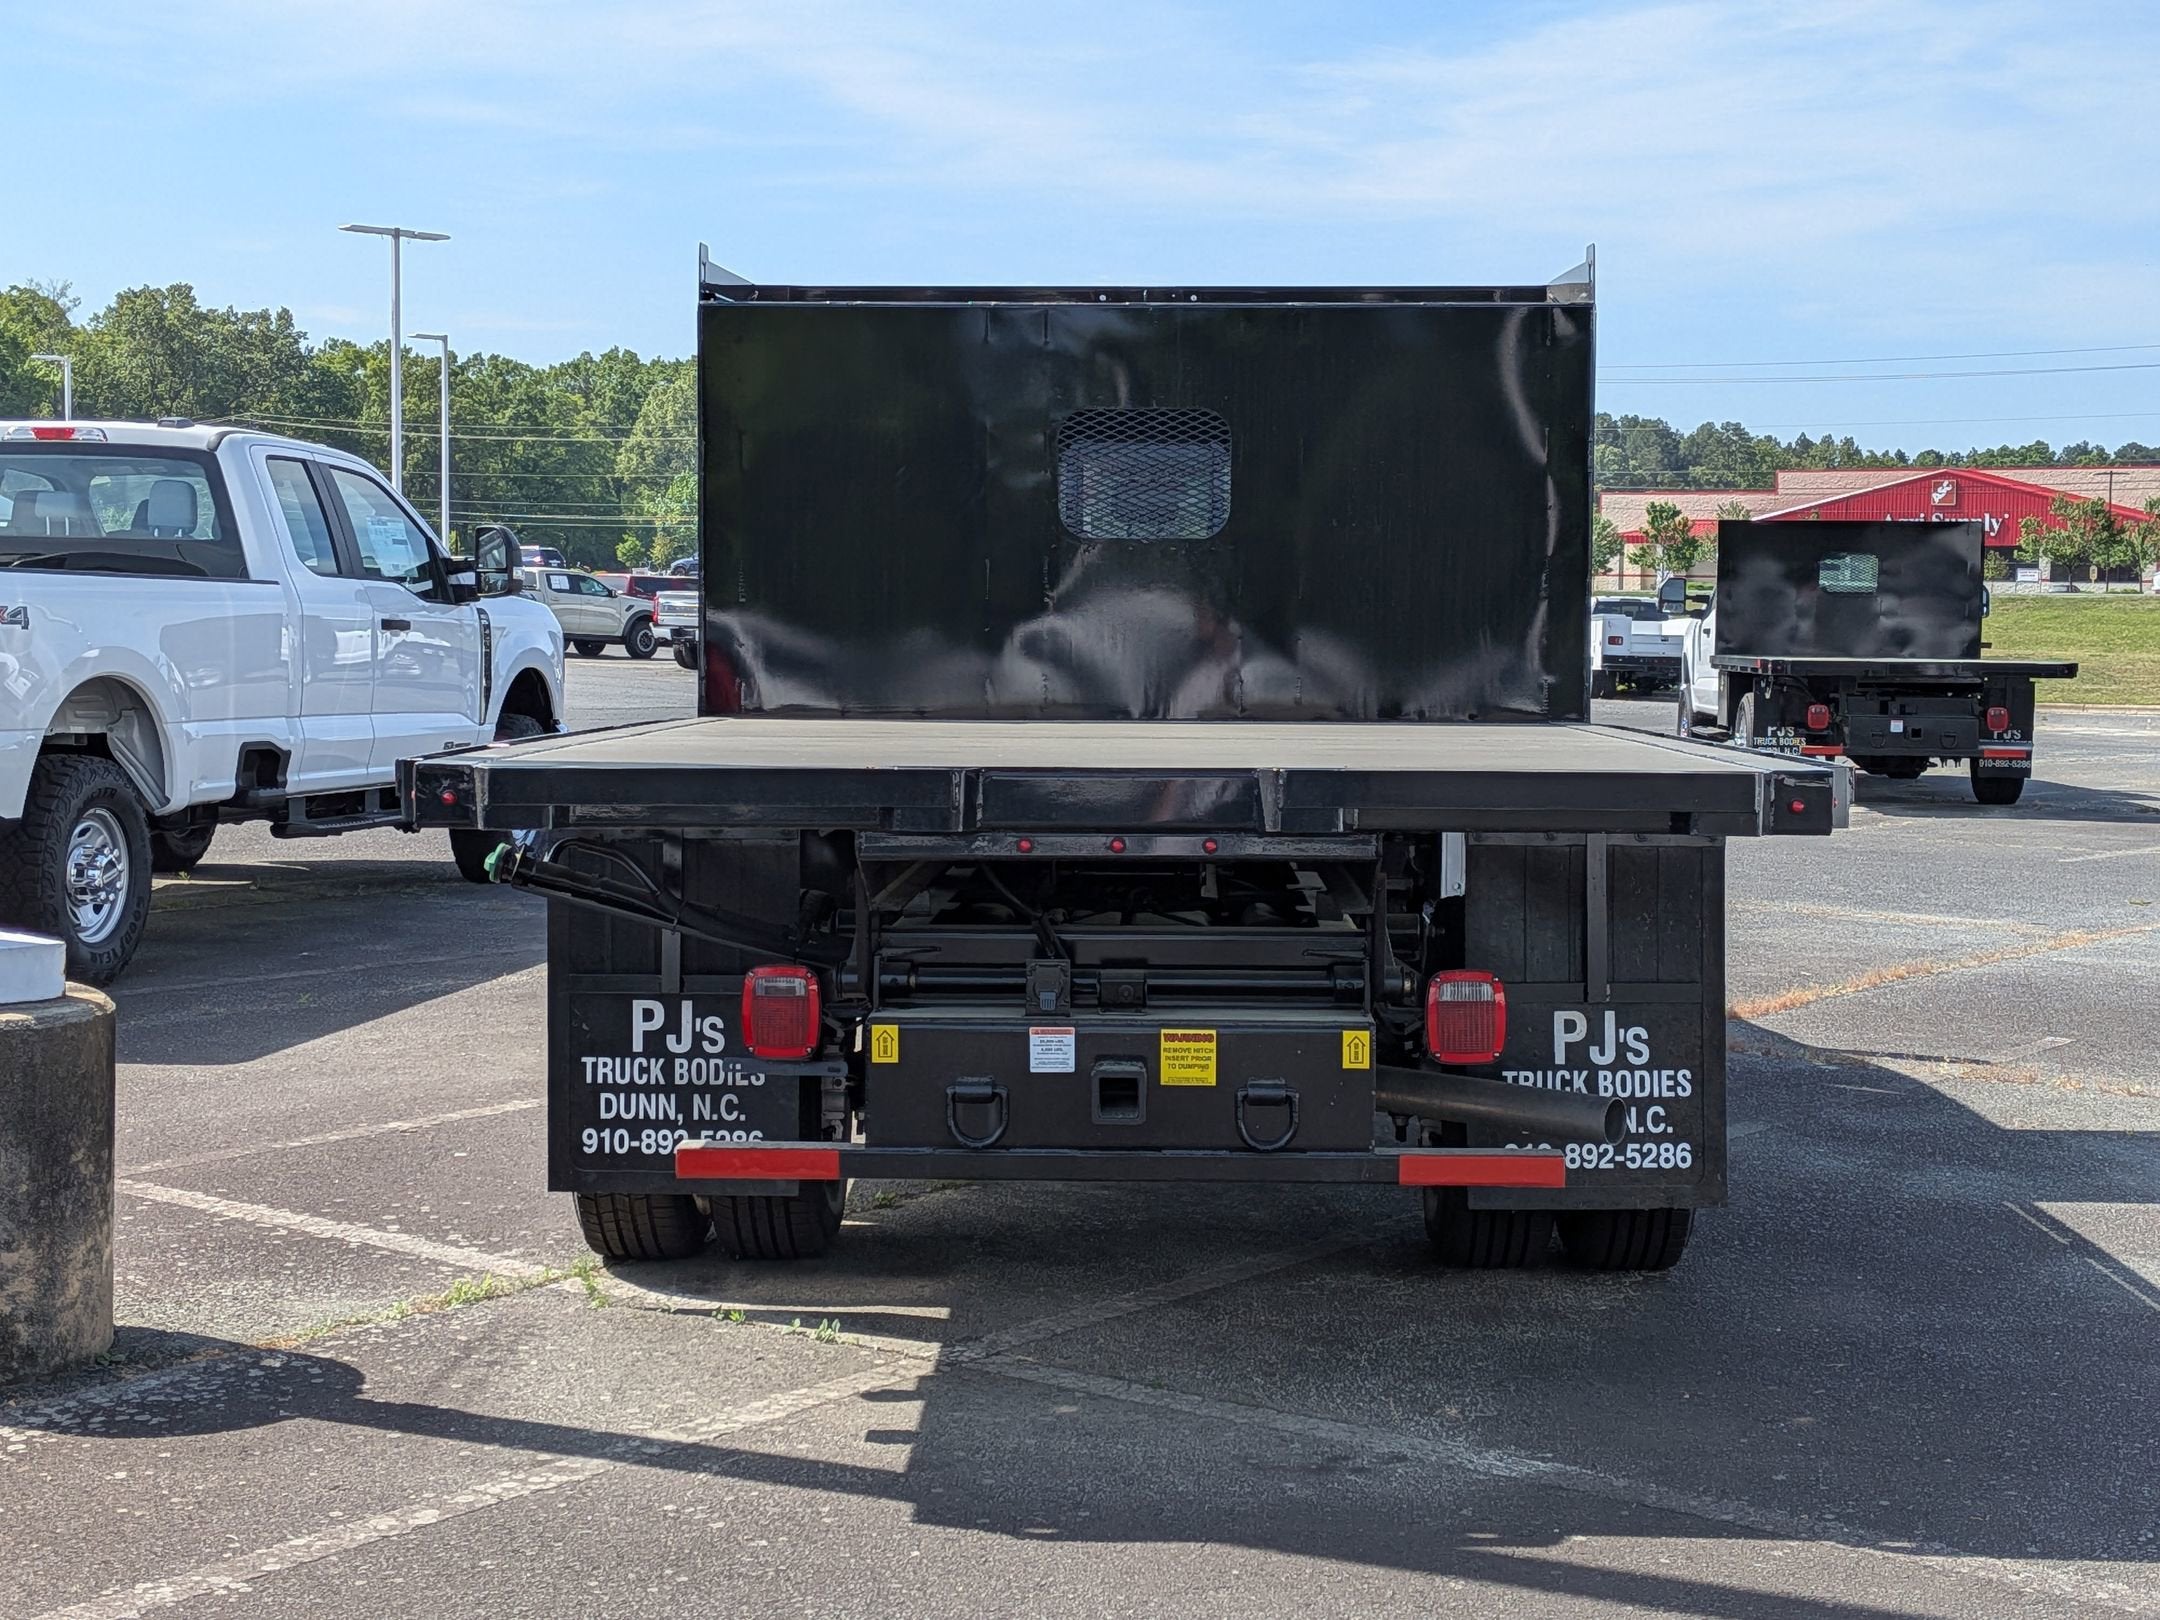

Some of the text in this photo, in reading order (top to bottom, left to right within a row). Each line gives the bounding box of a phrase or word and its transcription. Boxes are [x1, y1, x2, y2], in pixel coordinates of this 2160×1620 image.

[581, 1057, 666, 1086] TRUCK
[1598, 1069, 1692, 1098] BODIES
[600, 1093, 747, 1125] DUNN, N.C.
[581, 1127, 764, 1155] 910-89
